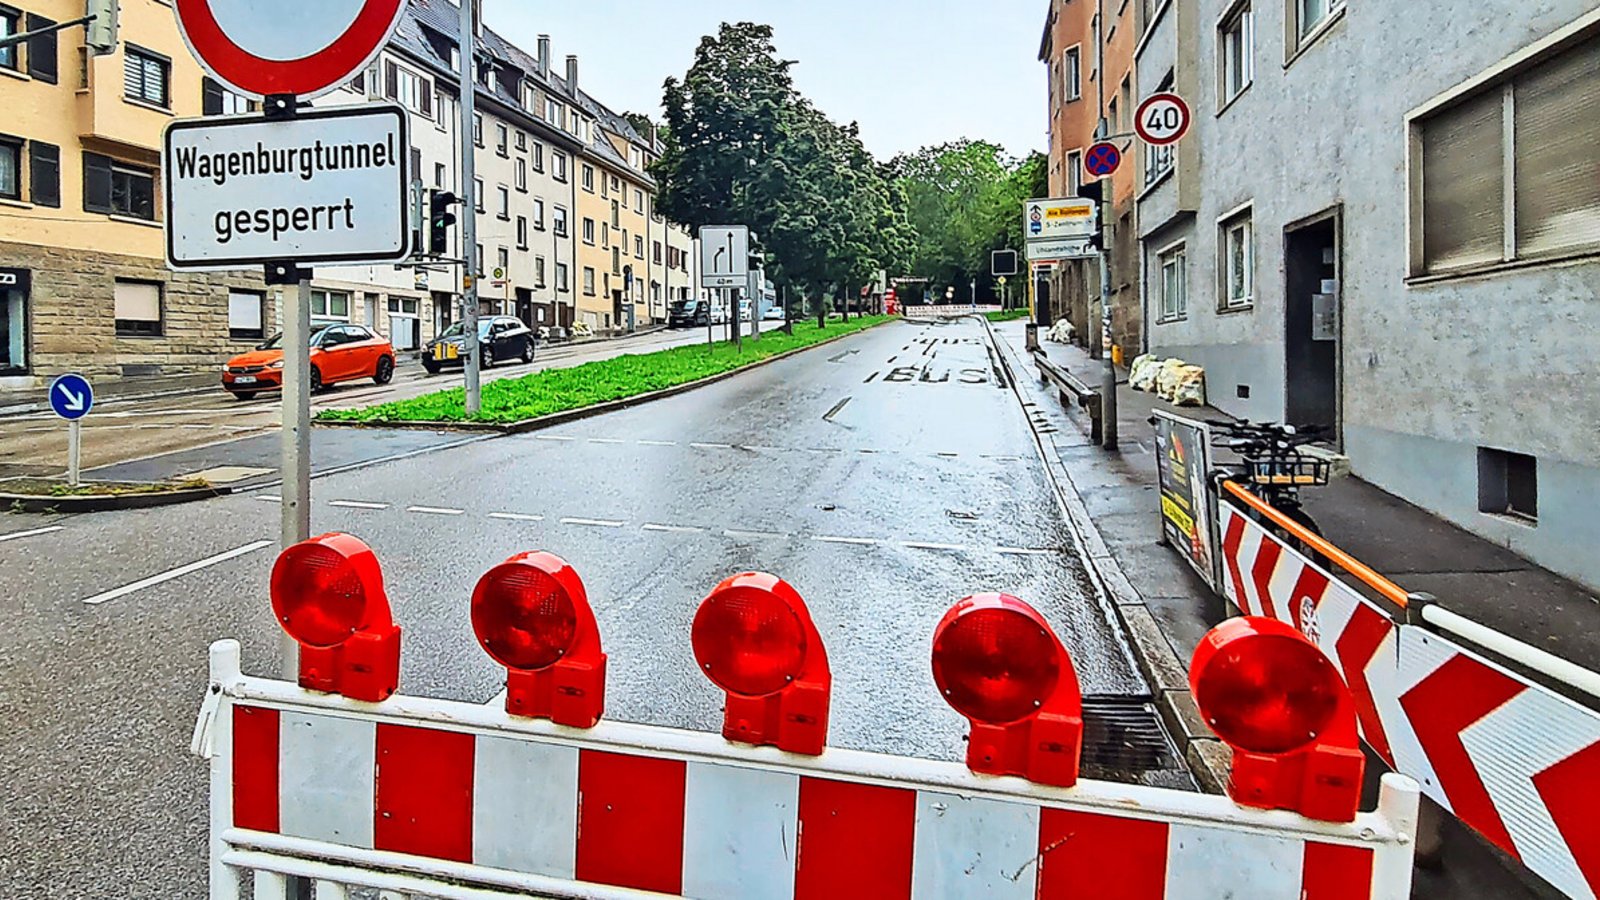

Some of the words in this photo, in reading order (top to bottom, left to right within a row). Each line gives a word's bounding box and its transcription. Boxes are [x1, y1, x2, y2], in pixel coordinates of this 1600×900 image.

[1146, 106, 1179, 131] 40
[175, 132, 396, 186] Wagenburgtunnel
[214, 197, 354, 244] gesperrt
[883, 366, 988, 383] BUS
